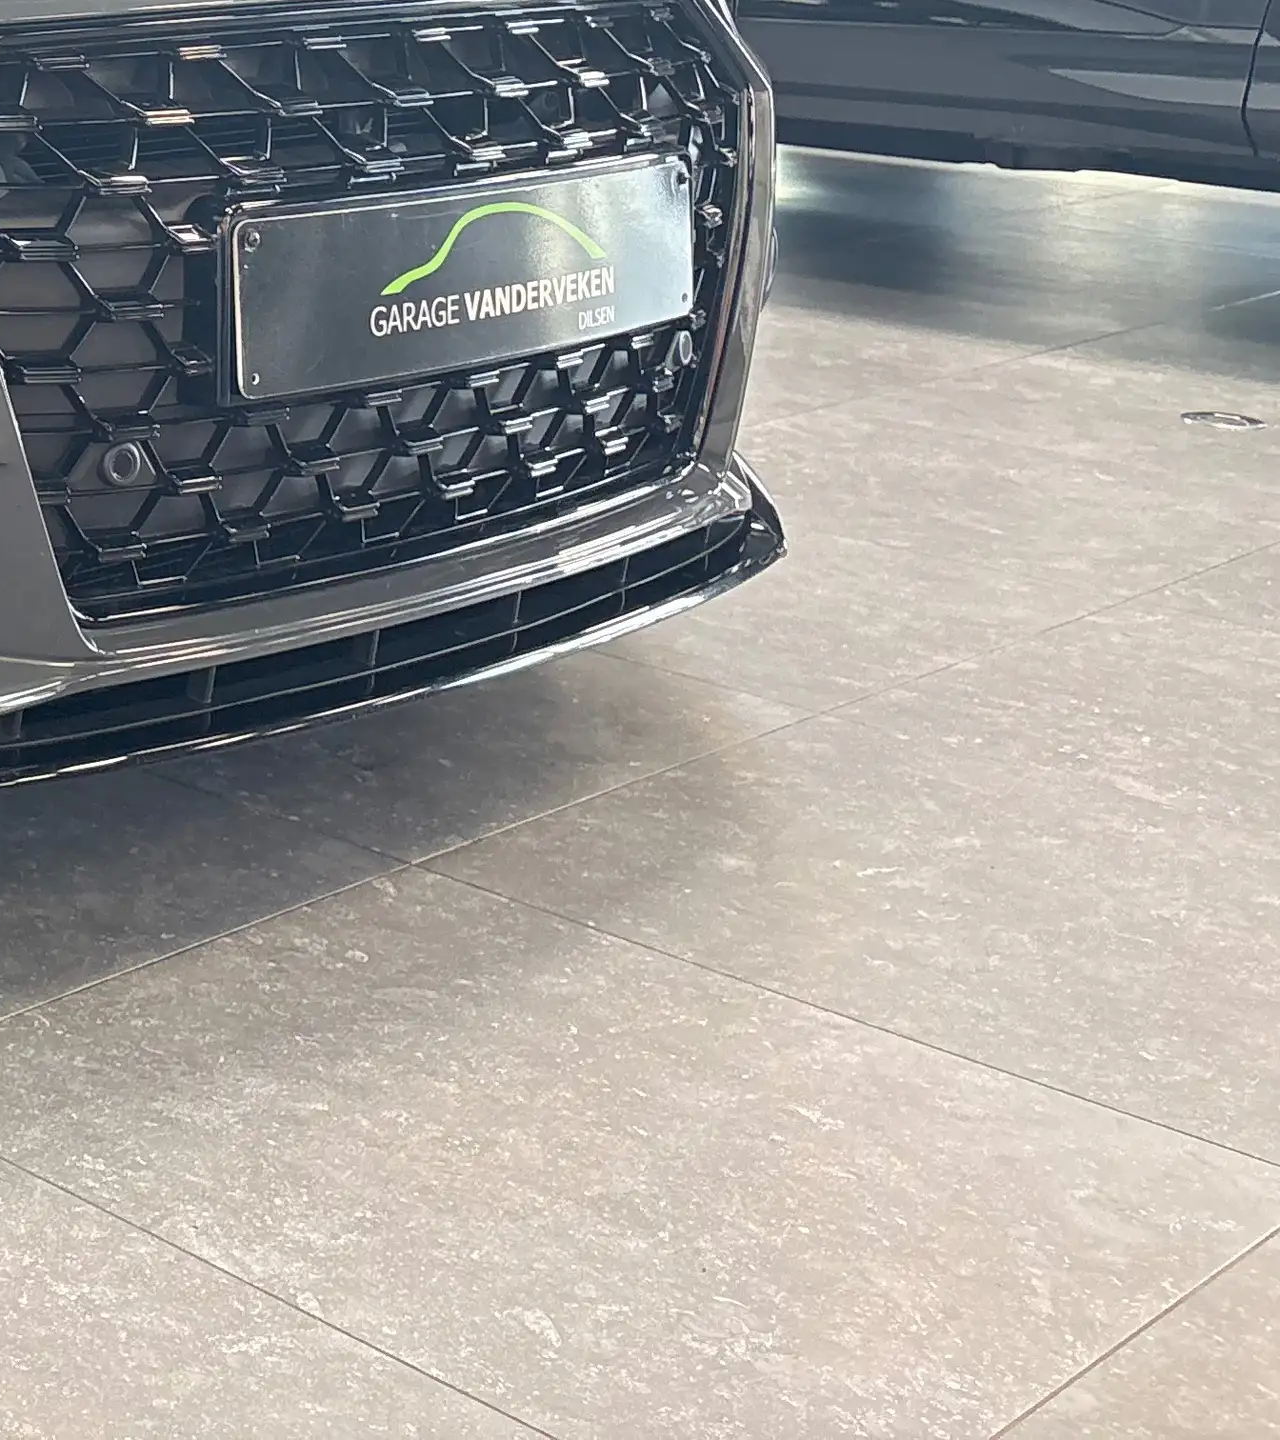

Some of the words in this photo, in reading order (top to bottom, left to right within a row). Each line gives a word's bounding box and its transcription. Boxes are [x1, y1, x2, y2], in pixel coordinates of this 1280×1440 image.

[370, 295, 460, 337] GARAGE
[464, 266, 615, 321] VANDERVEKEN
[578, 306, 615, 330] DILSEN
